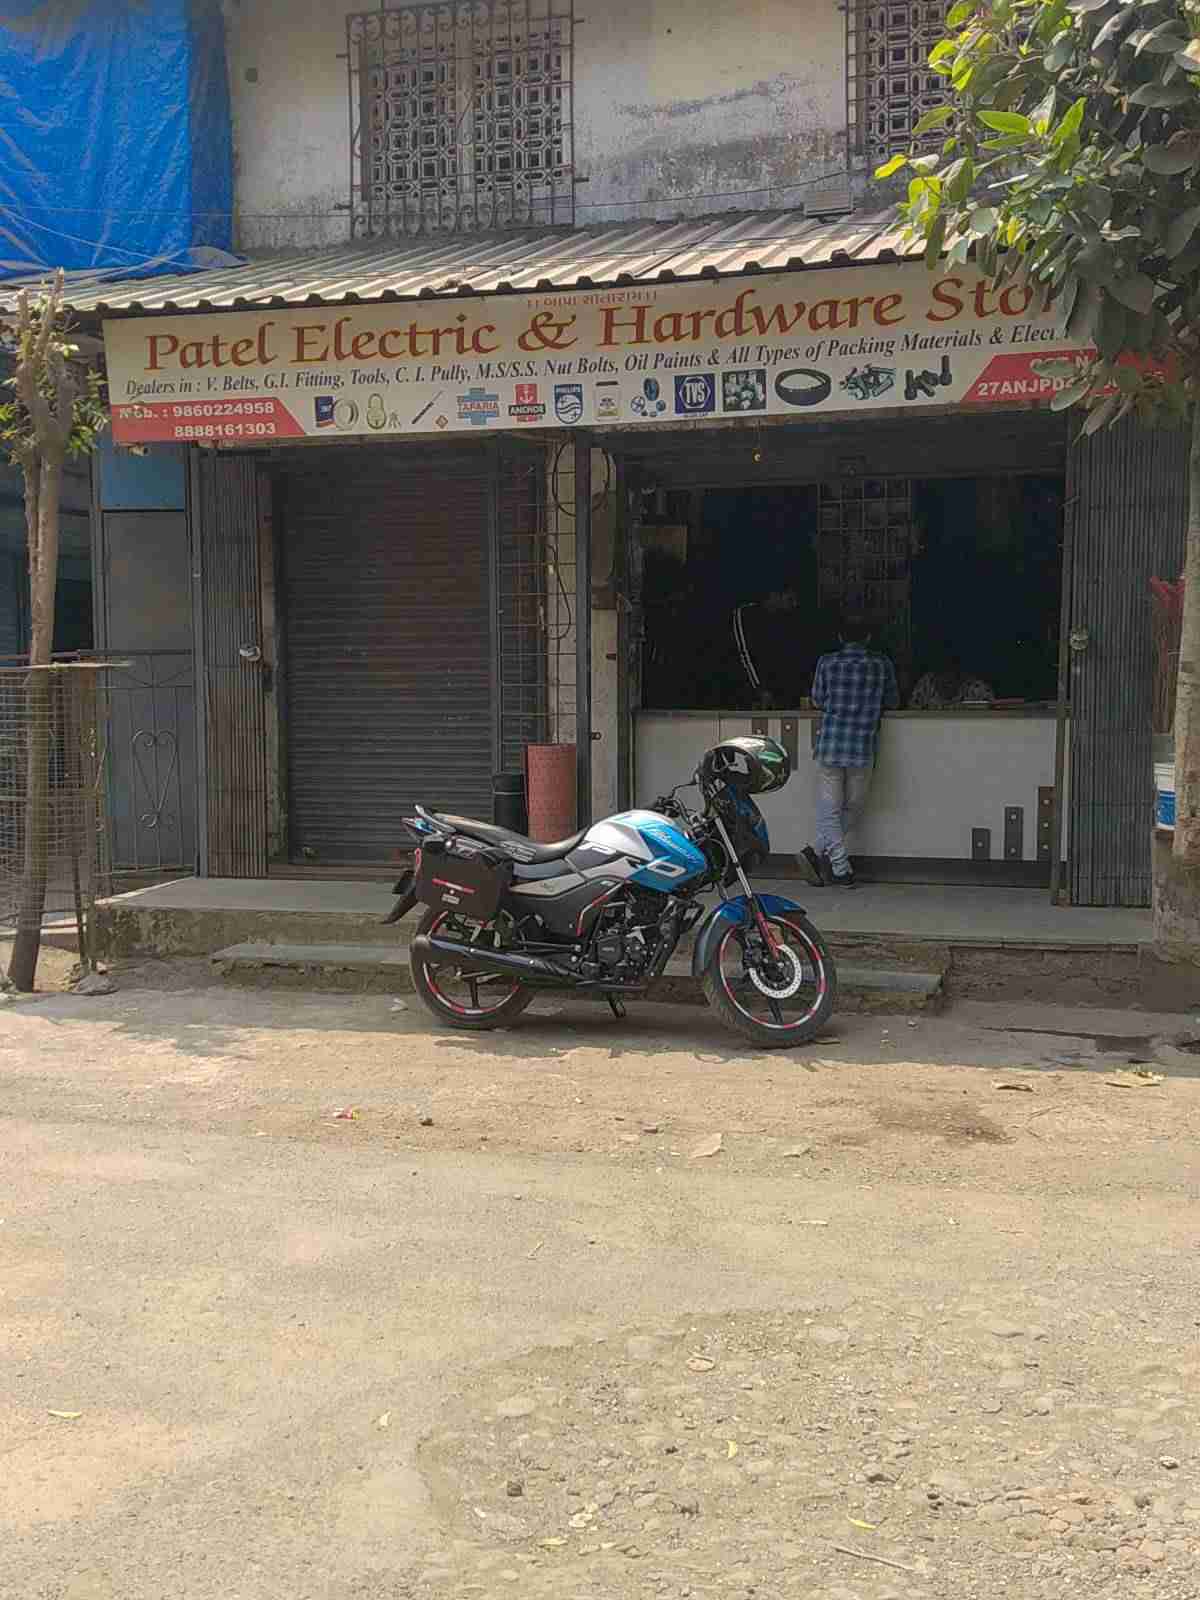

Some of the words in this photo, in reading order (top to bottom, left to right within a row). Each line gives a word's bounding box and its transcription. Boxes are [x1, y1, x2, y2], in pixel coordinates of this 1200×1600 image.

[144, 321, 279, 371] Patel
[290, 312, 500, 362] Electric
[517, 311, 578, 351] &
[595, 288, 906, 346] Hardware
[126, 378, 176, 395] Dealers
[179, 377, 192, 393] in
[207, 376, 218, 391] V.
[223, 374, 259, 392] Belts,
[264, 372, 289, 389] G.I.
[295, 368, 345, 390] Fitting,
[351, 367, 391, 385] Tools,
[396, 366, 409, 383] C.
[415, 365, 426, 382] I.
[430, 363, 472, 384] Pully,
[544, 359, 573, 376] Nut
[577, 356, 619, 375] Bolts,
[625, 353, 649, 371] Oil
[653, 351, 701, 369] Paints
[707, 348, 721, 365] &
[726, 345, 751, 364] All
[755, 343, 800, 366] Types
[805, 340, 826, 362] of
[827, 336, 897, 357] Packing
[901, 329, 982, 352] Materials
[989, 326, 1002, 345] &
[685, 382, 705, 403] TVS
[173, 401, 275, 418] 9860224958
[175, 422, 276, 437] 8888161303
